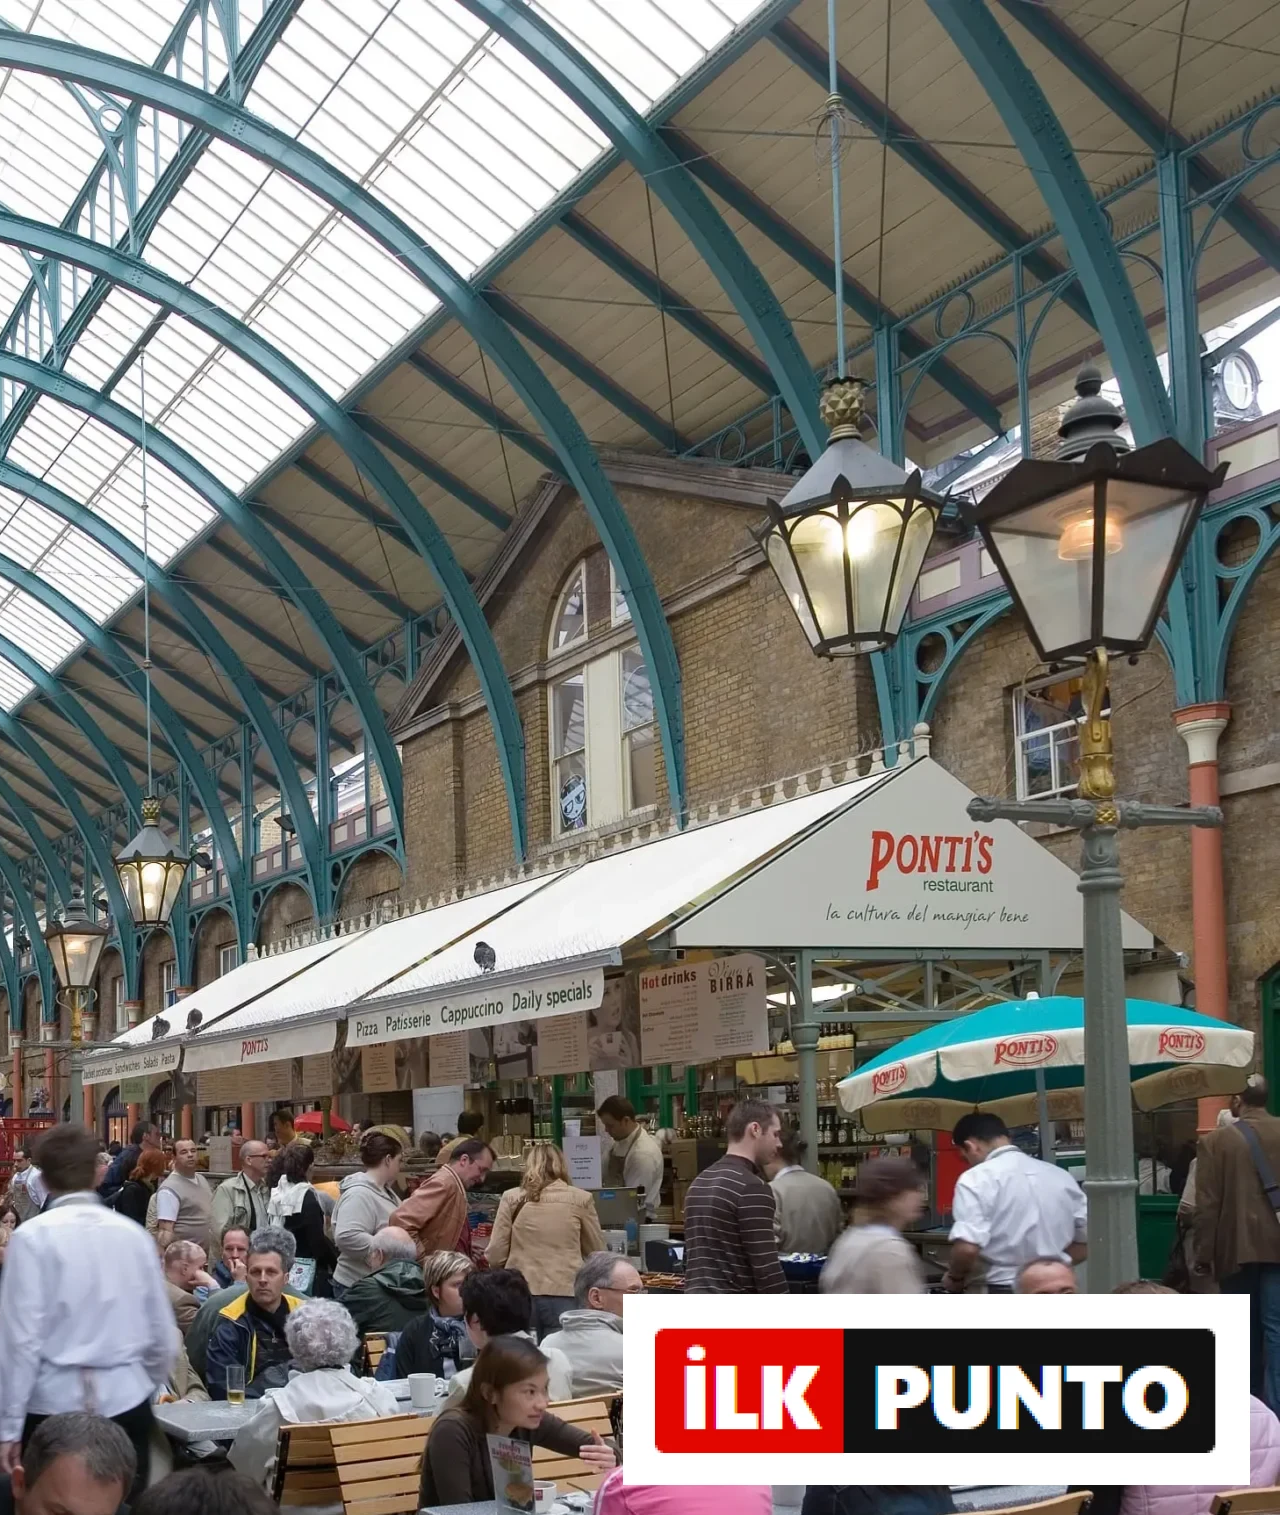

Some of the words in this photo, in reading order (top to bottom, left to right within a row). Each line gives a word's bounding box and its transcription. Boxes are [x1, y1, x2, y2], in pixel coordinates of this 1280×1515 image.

[866, 830, 994, 892] PONTI'S
[923, 877, 994, 893] restaurant
[826, 902, 841, 921] la
[847, 904, 901, 922] cultura
[907, 904, 928, 922] del
[932, 908, 996, 930] mangiar
[999, 906, 1030, 923] bene
[641, 975, 660, 991] Hot
[661, 969, 697, 987] drinks
[709, 972, 754, 994] BIRRA
[356, 1020, 379, 1038] Pizza
[385, 1012, 431, 1033] Patisserie
[440, 998, 504, 1025] Cappuccino
[512, 990, 543, 1012] Daily
[546, 979, 593, 1009] specials
[240, 1037, 269, 1062] PONTI'S
[994, 1037, 1054, 1065] PONTI'S
[1158, 1033, 1204, 1055] PONTI'S
[872, 1063, 907, 1096] PONTI'S
